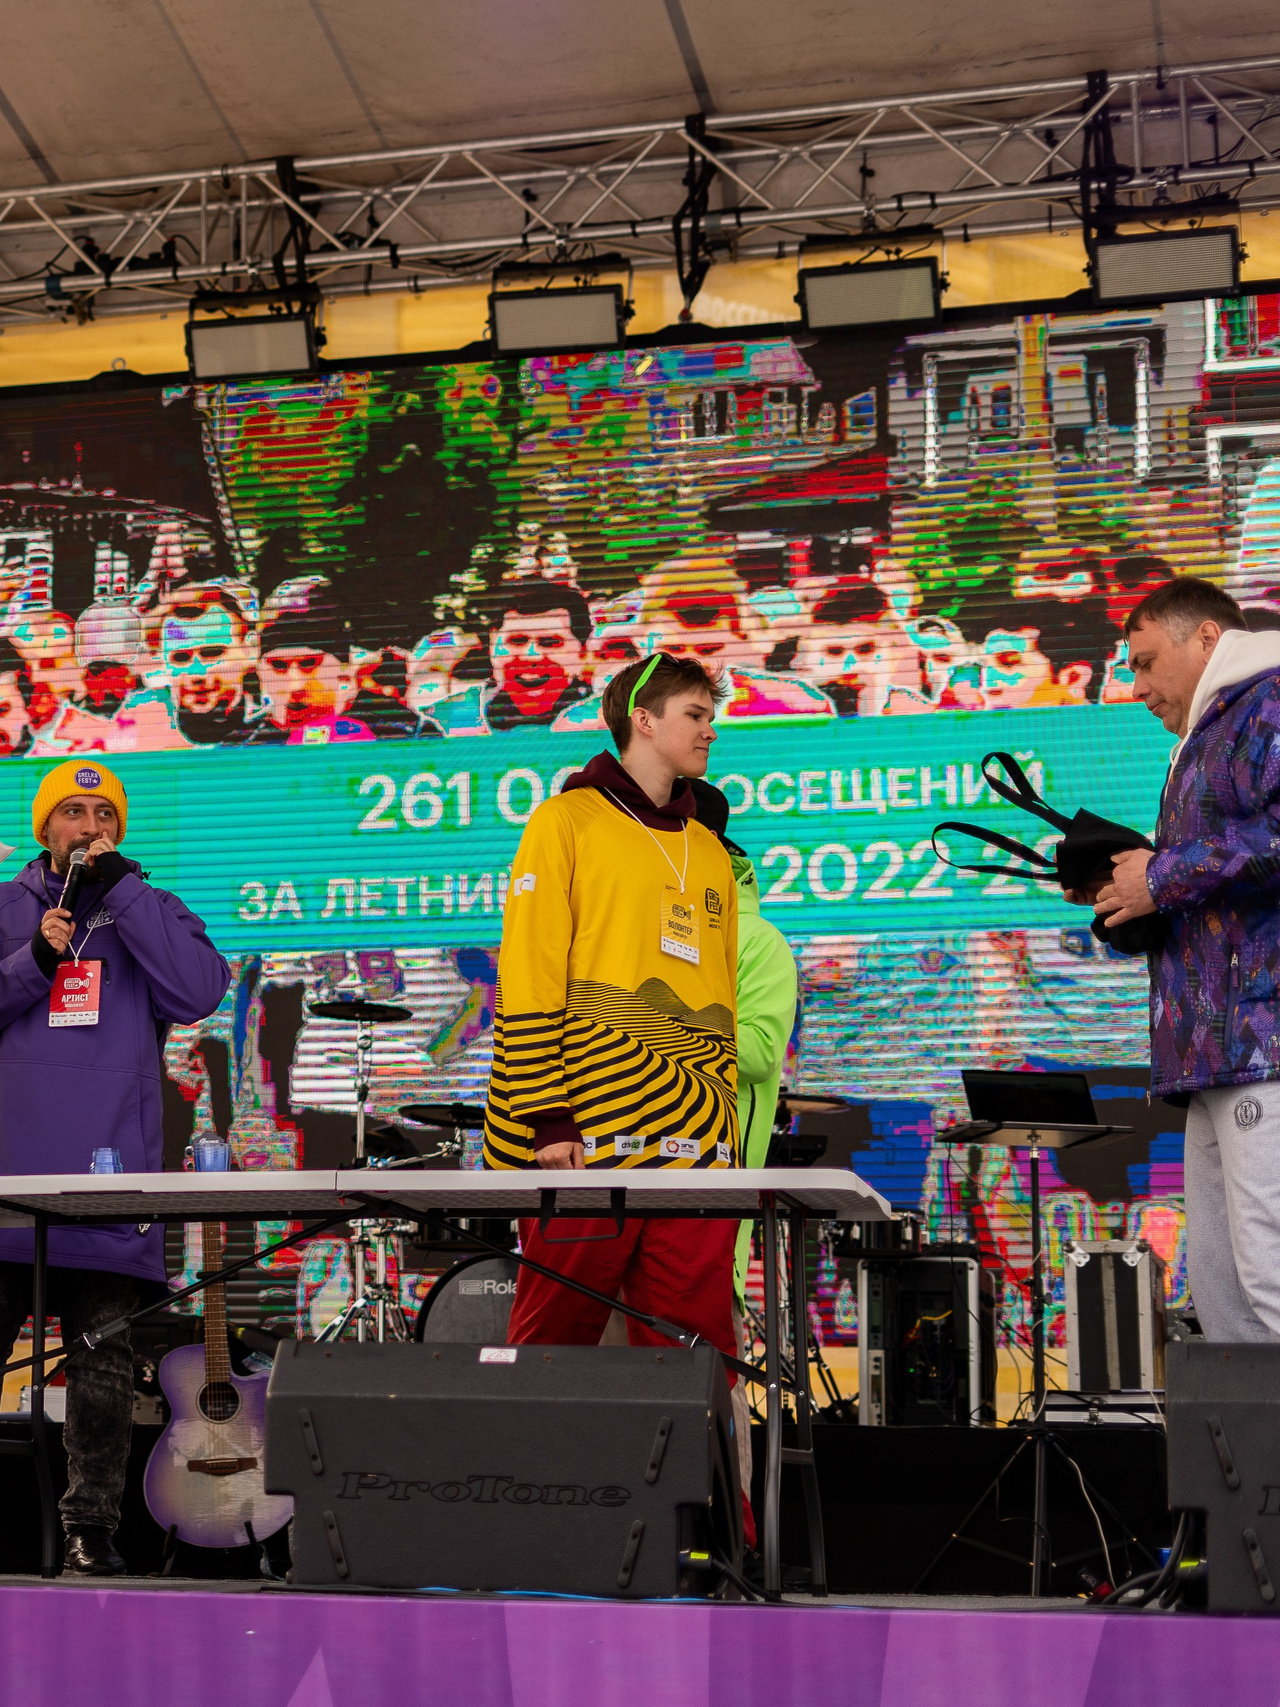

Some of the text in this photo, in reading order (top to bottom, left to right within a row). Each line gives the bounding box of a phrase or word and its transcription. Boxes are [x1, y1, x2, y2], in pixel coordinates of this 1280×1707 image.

[358, 771, 471, 829] 261
[712, 751, 1045, 815] ОСЕЩЕНИЙ
[238, 880, 303, 920] ЗА
[61, 994, 89, 1003] АРТИСТ
[483, 1279, 517, 1295] Rola
[337, 1471, 632, 1507] ProTone
